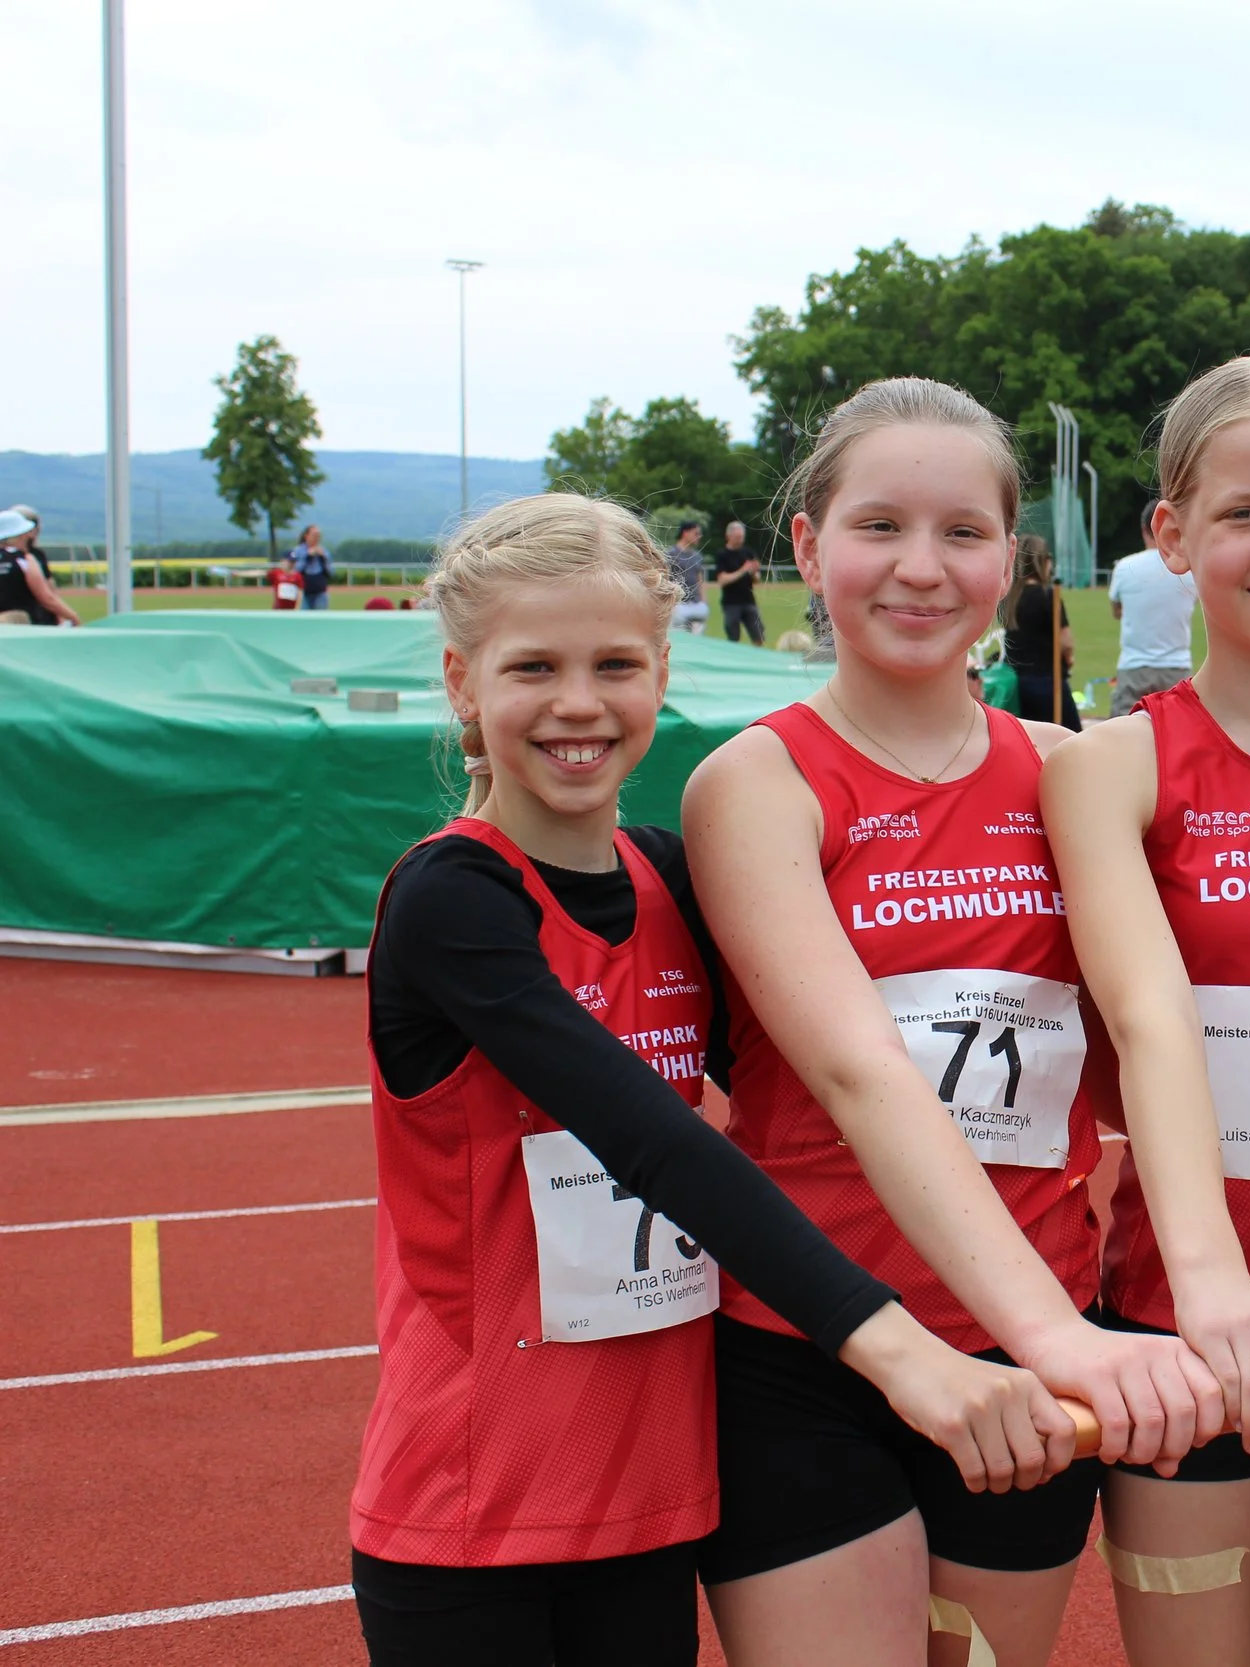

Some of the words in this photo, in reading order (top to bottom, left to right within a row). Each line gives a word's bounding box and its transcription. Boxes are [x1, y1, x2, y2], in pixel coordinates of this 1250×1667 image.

[1004, 812, 1035, 823] TSG
[876, 829, 888, 838] lo
[889, 827, 921, 842] sport
[1213, 825, 1225, 836] lo
[868, 864, 1050, 892] FREIZEITPARK
[852, 887, 1067, 930] LOCHMÜHLE
[659, 969, 684, 982] TSG
[955, 990, 991, 1004] Kreis
[993, 991, 1025, 1009] Einzel
[894, 1006, 971, 1024] isterschaft
[975, 1005, 1036, 1029] U16/U14/U12
[1038, 1021, 1064, 1031] 2026
[931, 1020, 1022, 1109] 71
[960, 1106, 1032, 1131] Kaczmarzyk
[964, 1126, 1017, 1143] Wehrheim
[615, 1275, 659, 1295] Anna
[634, 1292, 664, 1310] TSG
[567, 1319, 590, 1330] W12
